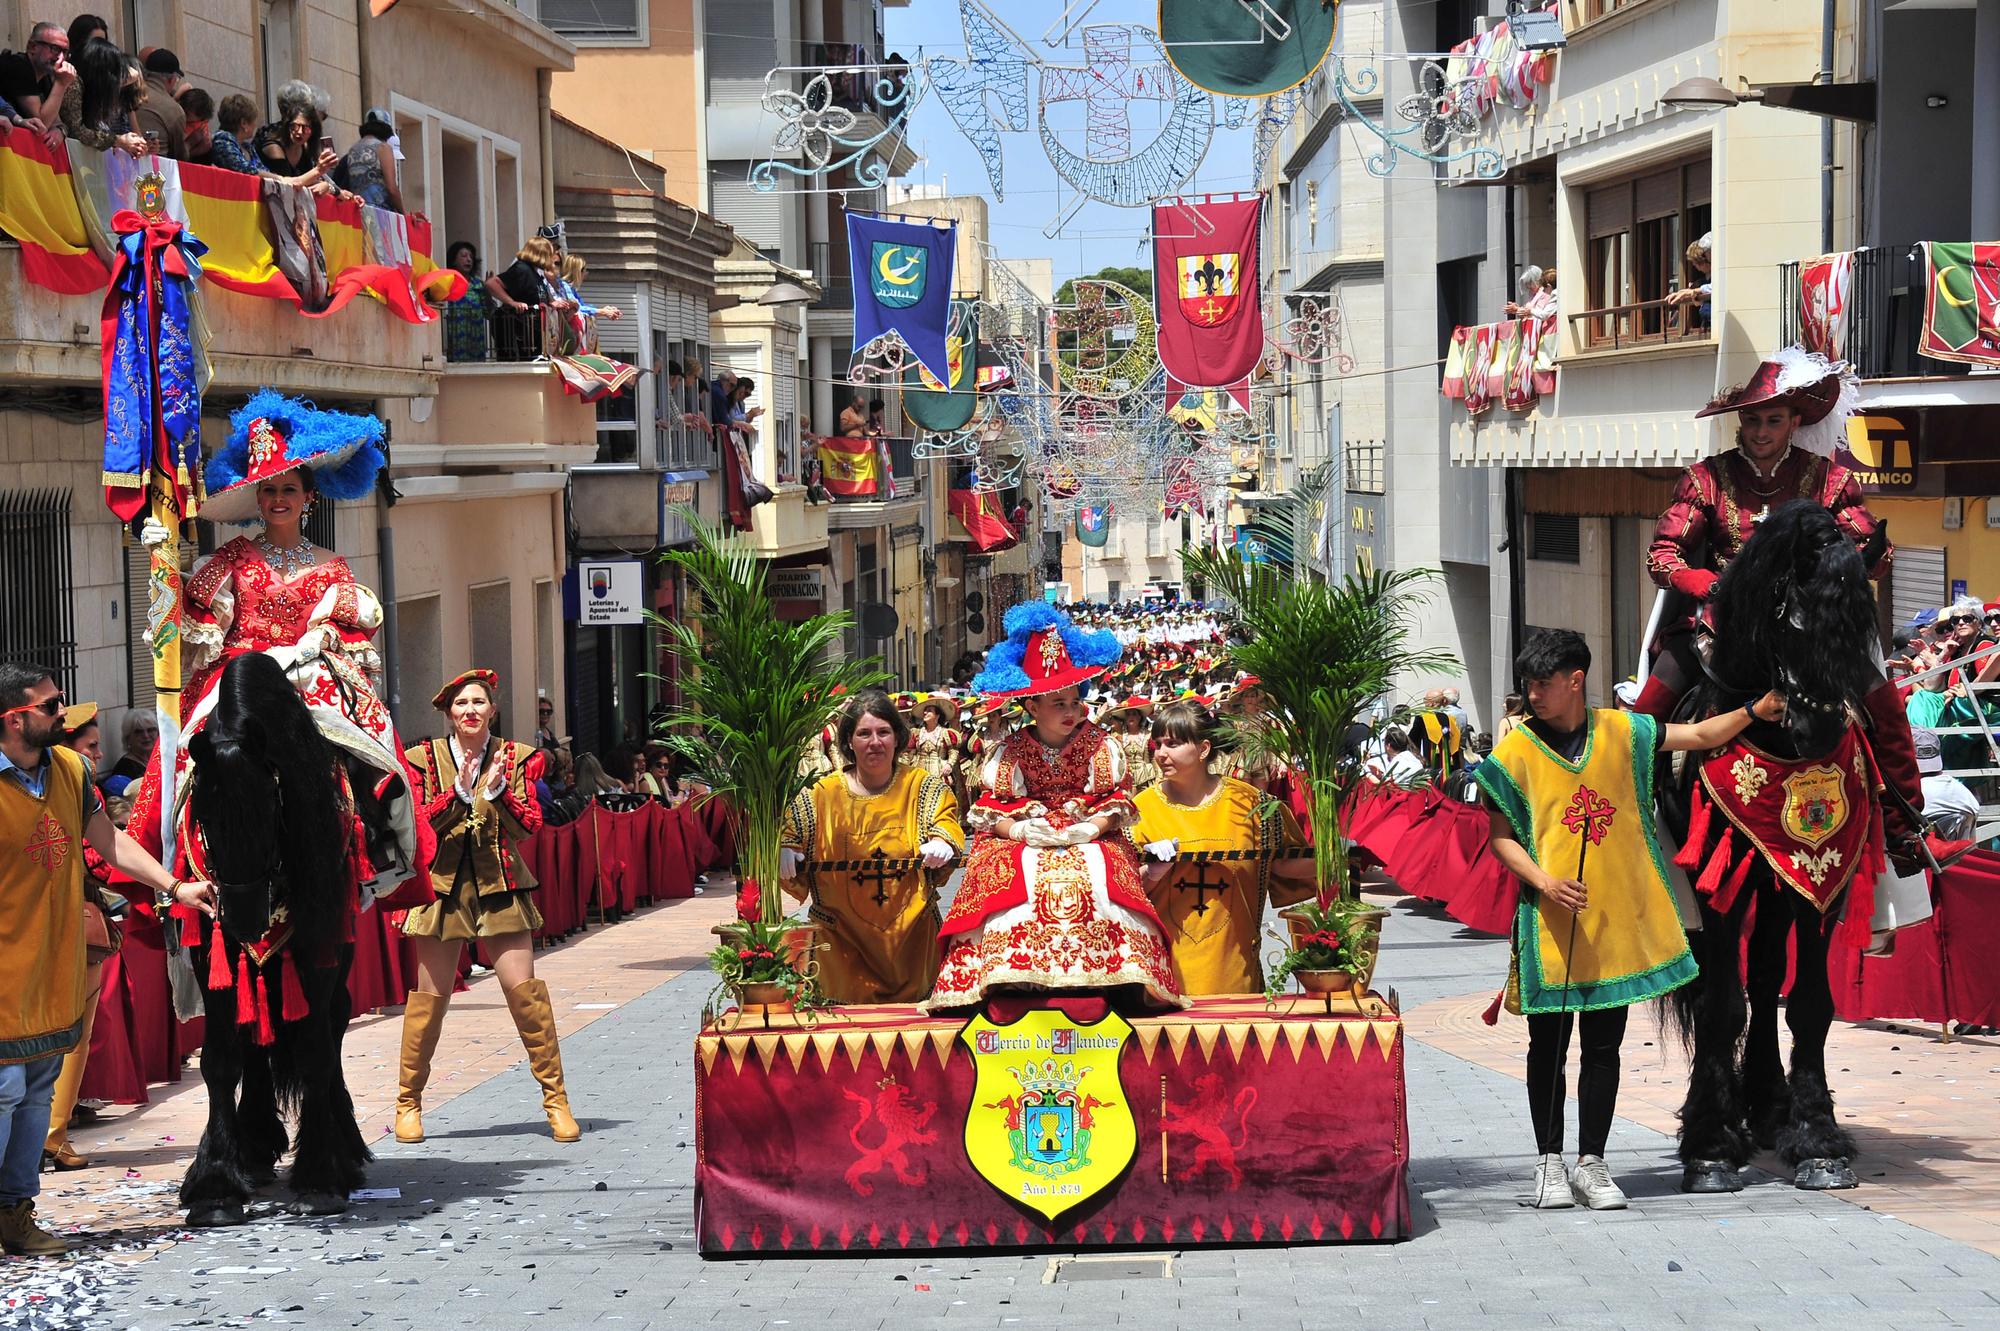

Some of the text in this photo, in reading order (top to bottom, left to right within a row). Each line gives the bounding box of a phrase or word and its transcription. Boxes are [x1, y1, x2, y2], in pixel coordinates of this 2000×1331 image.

[1851, 472, 1912, 485] STANCO
[777, 573, 811, 581] DIARIO
[769, 584, 819, 597] INFORMACION
[976, 1028, 1119, 1054] Tercio de Flandes
[1051, 1184, 1081, 1195] 1.879
